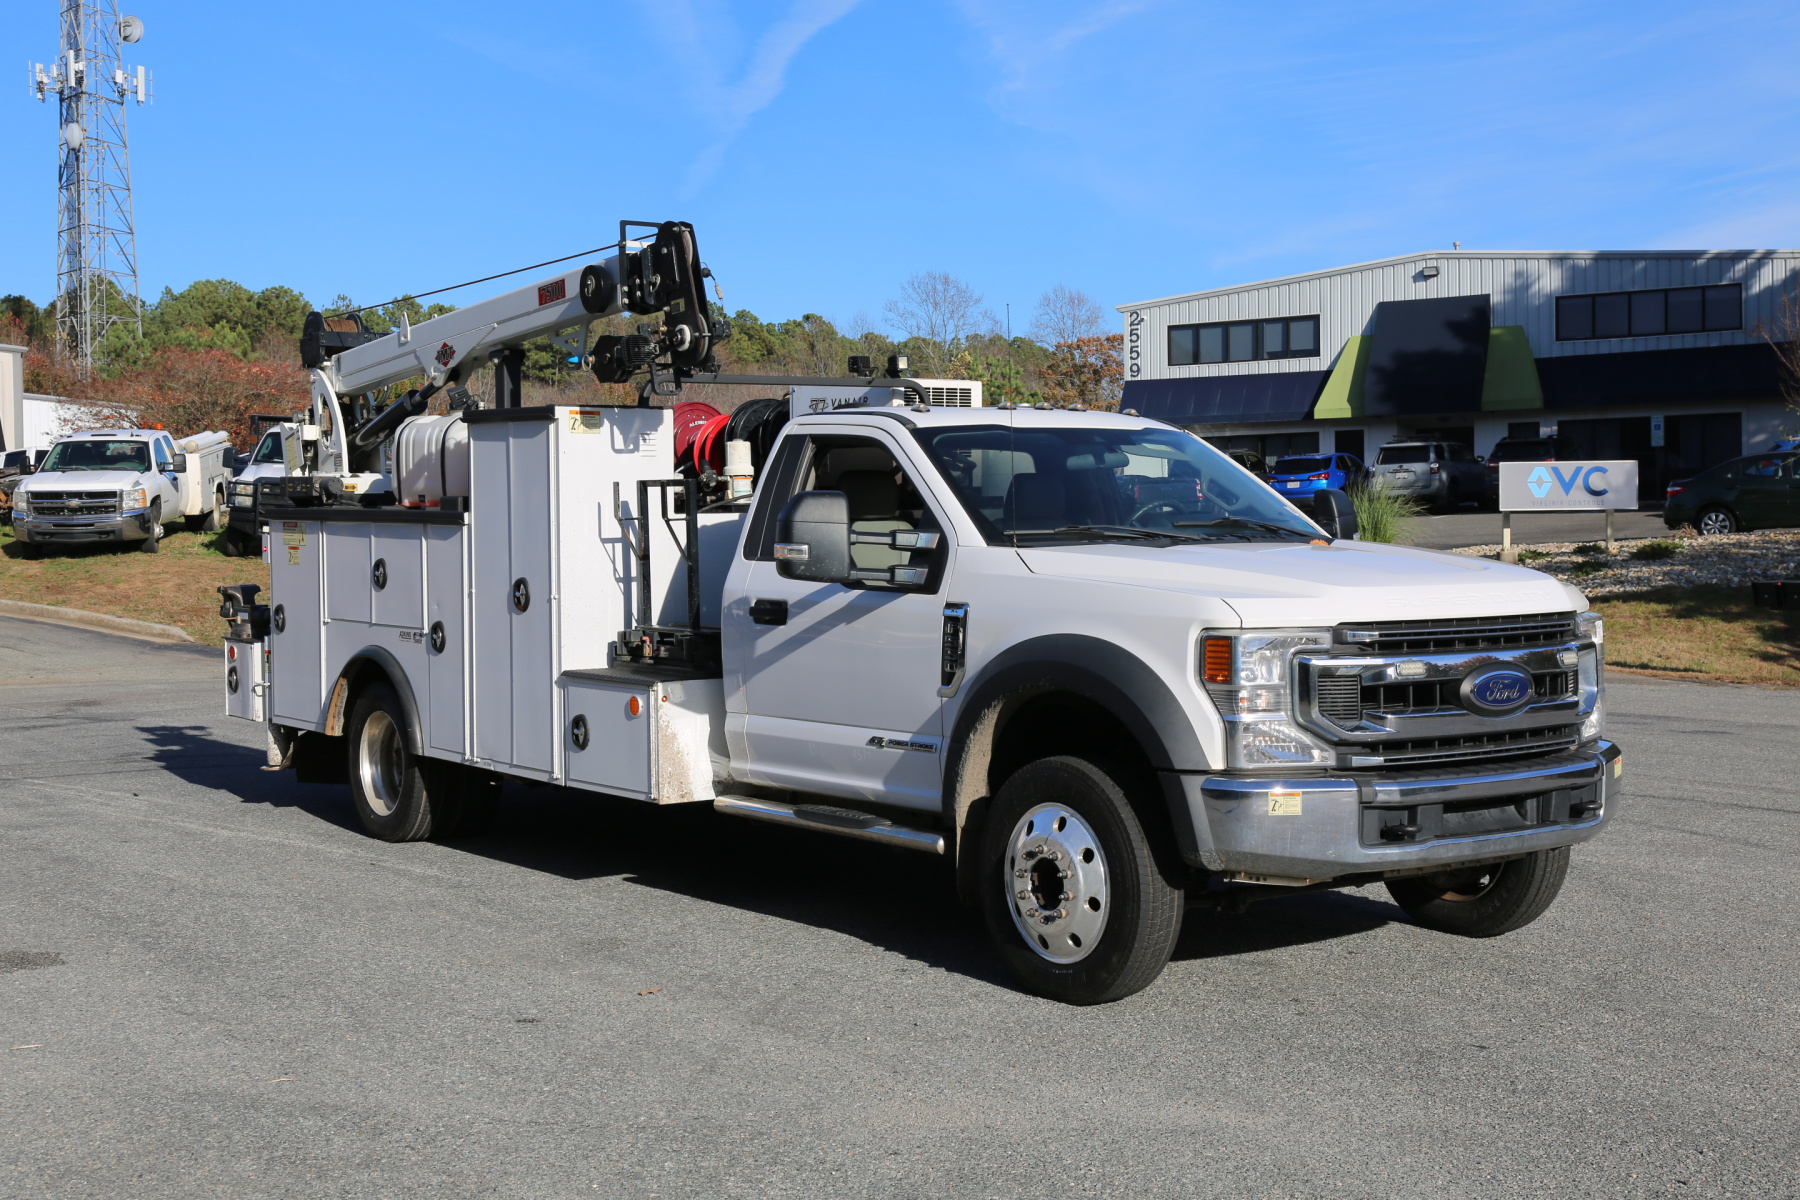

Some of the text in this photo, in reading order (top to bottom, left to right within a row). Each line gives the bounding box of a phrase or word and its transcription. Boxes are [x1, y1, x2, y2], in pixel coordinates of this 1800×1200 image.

[541, 282, 563, 303] 7500
[1129, 311, 1140, 378] 2559
[1385, 590, 1552, 608] SUPER DUTY
[1487, 679, 1520, 701] Ford
[889, 739, 909, 747] POWER
